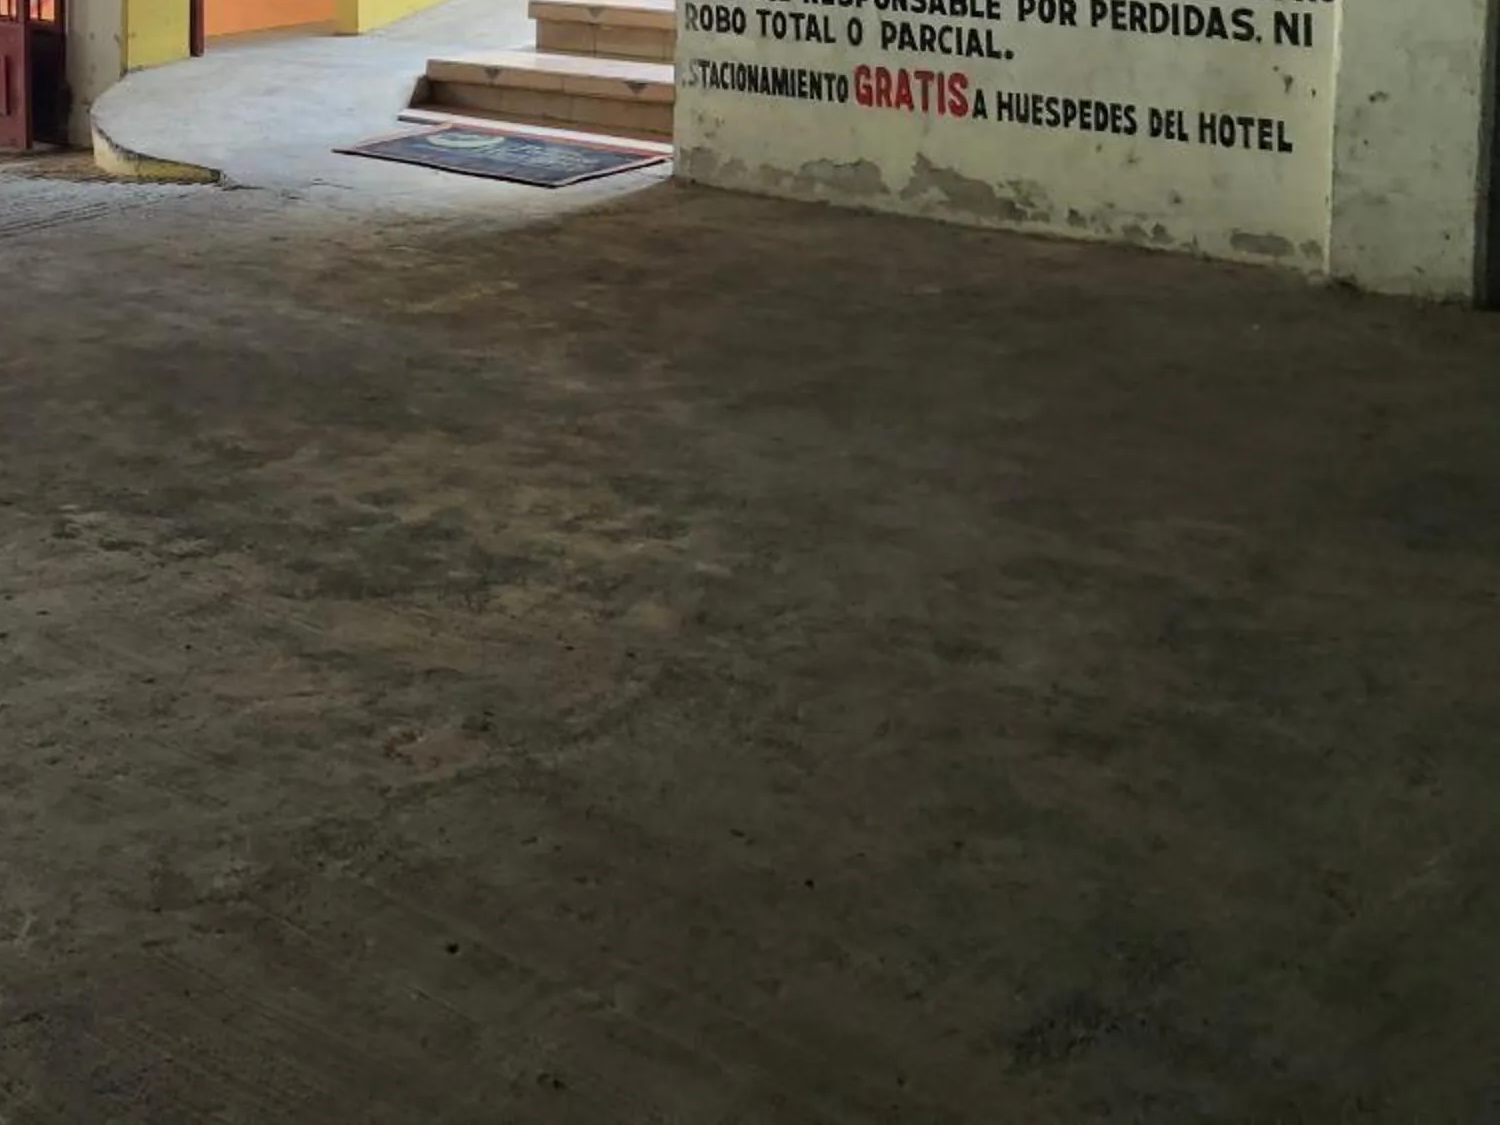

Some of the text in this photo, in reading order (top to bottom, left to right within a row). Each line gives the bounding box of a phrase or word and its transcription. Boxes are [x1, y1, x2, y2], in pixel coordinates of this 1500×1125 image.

[684, 2, 1015, 61] ROBO TOTAL O PARCIAL.
[1273, 10, 1314, 48] NI
[680, 57, 1295, 154] STACIONAMIENTO GRATIS A HUESPEDES DEL HOTEL
